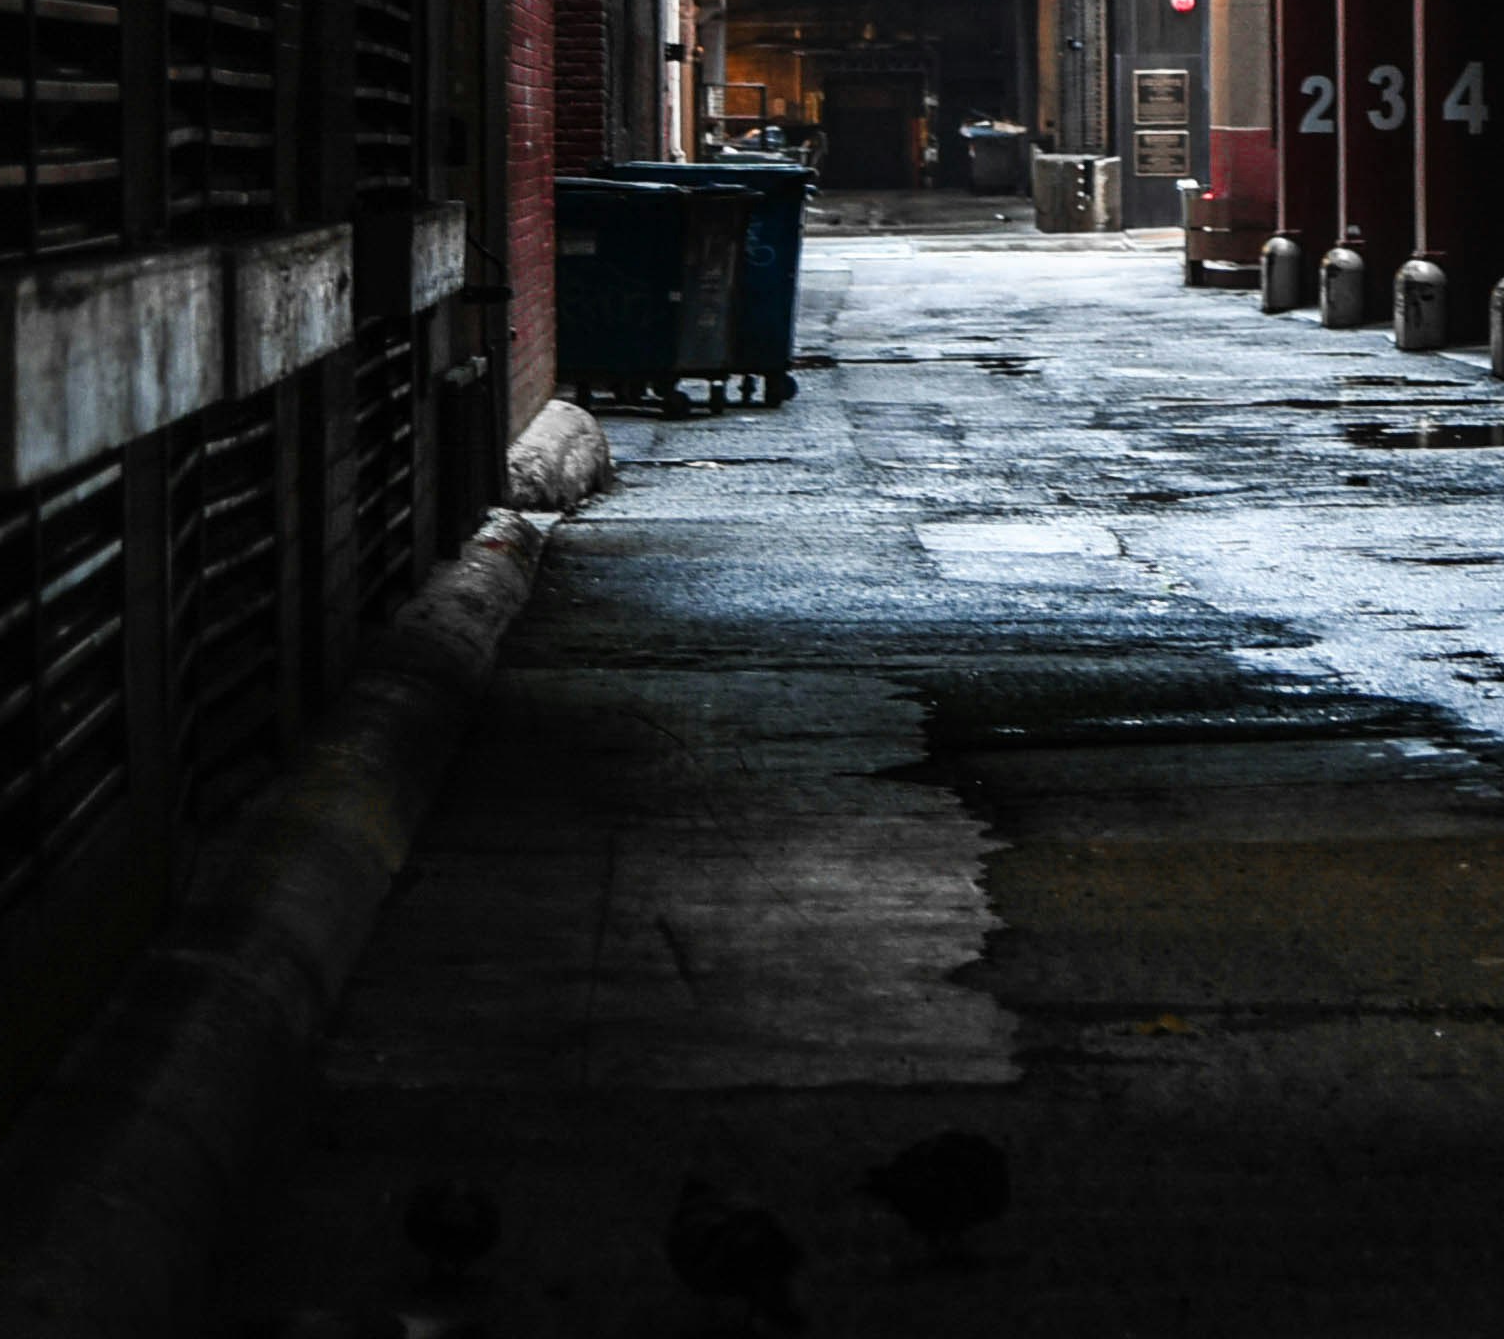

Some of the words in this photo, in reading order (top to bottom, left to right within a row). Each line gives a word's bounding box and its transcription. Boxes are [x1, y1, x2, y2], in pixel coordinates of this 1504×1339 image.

[1298, 75, 1336, 134] 2
[1366, 64, 1407, 131] 3
[1441, 61, 1490, 135] 4
